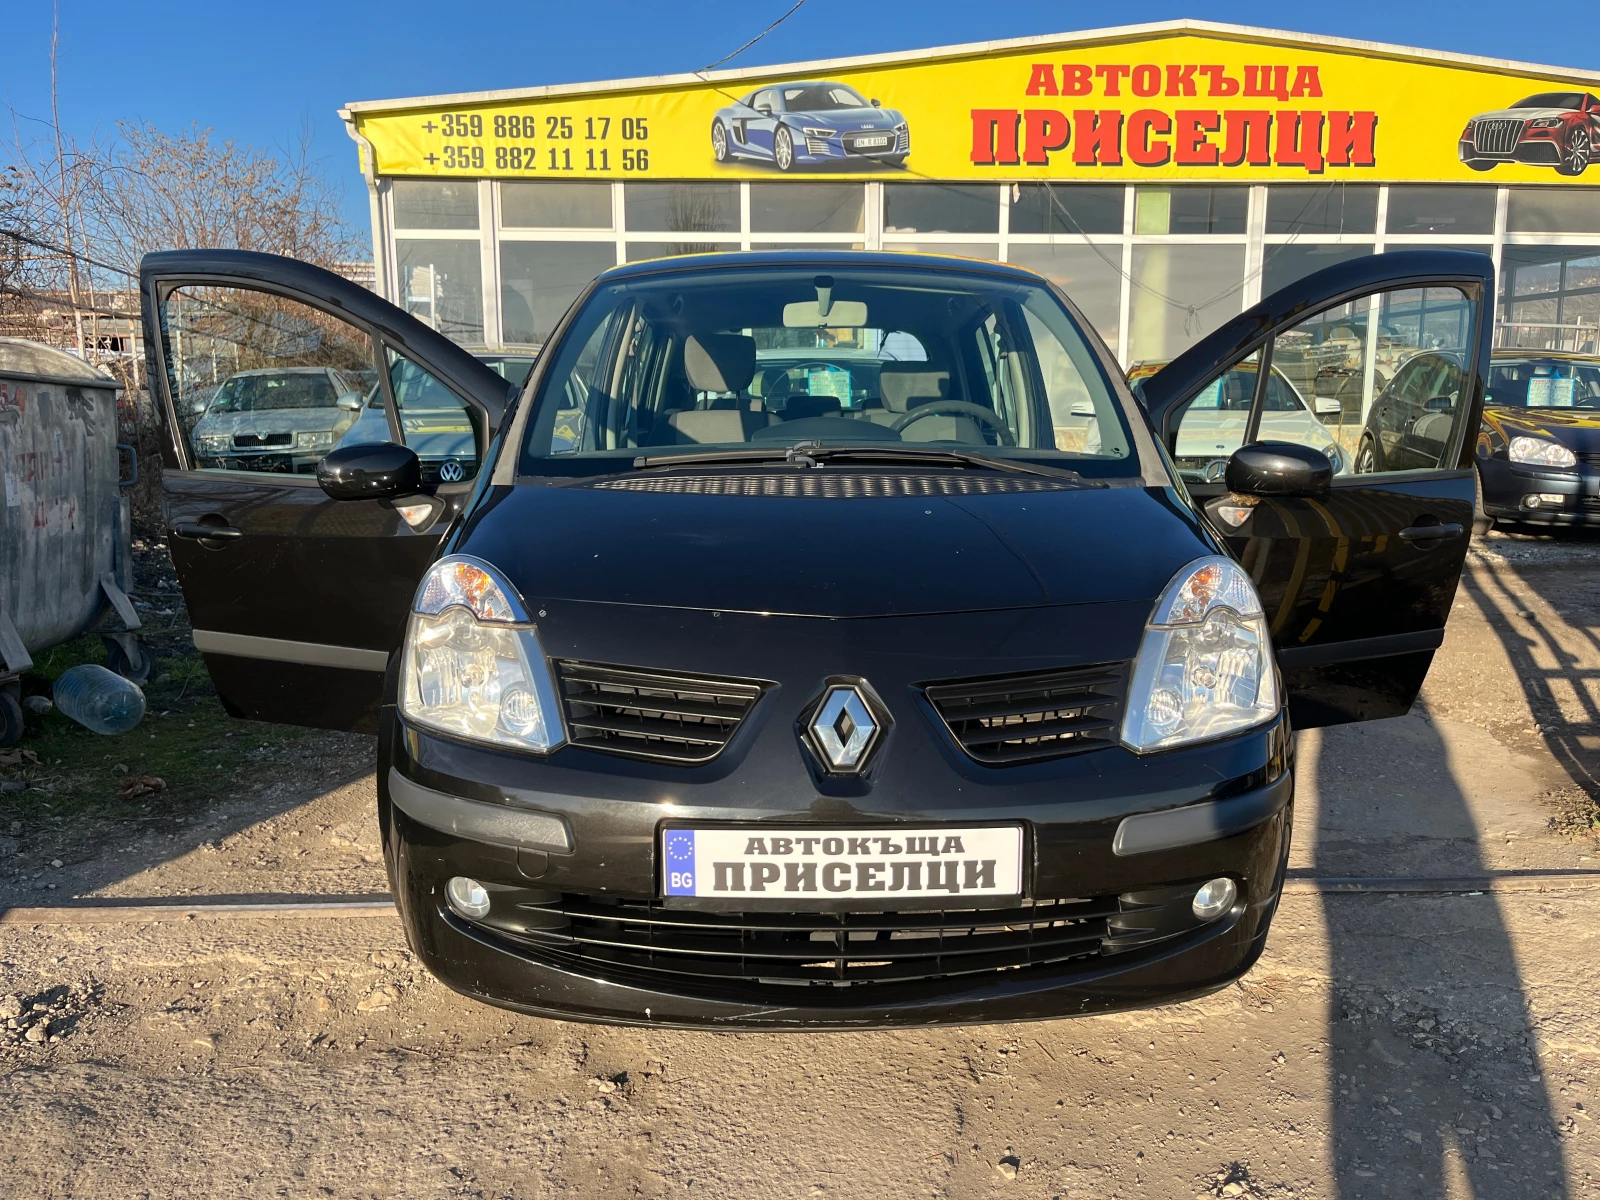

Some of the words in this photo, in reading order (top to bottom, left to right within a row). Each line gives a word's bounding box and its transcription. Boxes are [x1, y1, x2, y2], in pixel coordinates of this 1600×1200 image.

[1026, 64, 1323, 101] АВТОКЪЩА
[421, 113, 483, 138] +359
[493, 115, 535, 139] 886
[546, 116, 573, 140] 25
[584, 117, 611, 140] 17
[621, 117, 648, 141] 05
[971, 109, 1378, 174] ПРИСЕЛЦИ
[423, 145, 484, 169] +359
[495, 146, 536, 170] 882
[548, 147, 574, 170] 11
[585, 148, 611, 171] 11
[622, 148, 649, 171] 56
[744, 836, 965, 857] АВТОКЪЩА
[671, 872, 693, 888] BG
[713, 860, 996, 893] ПРИСЕЛЦИ
